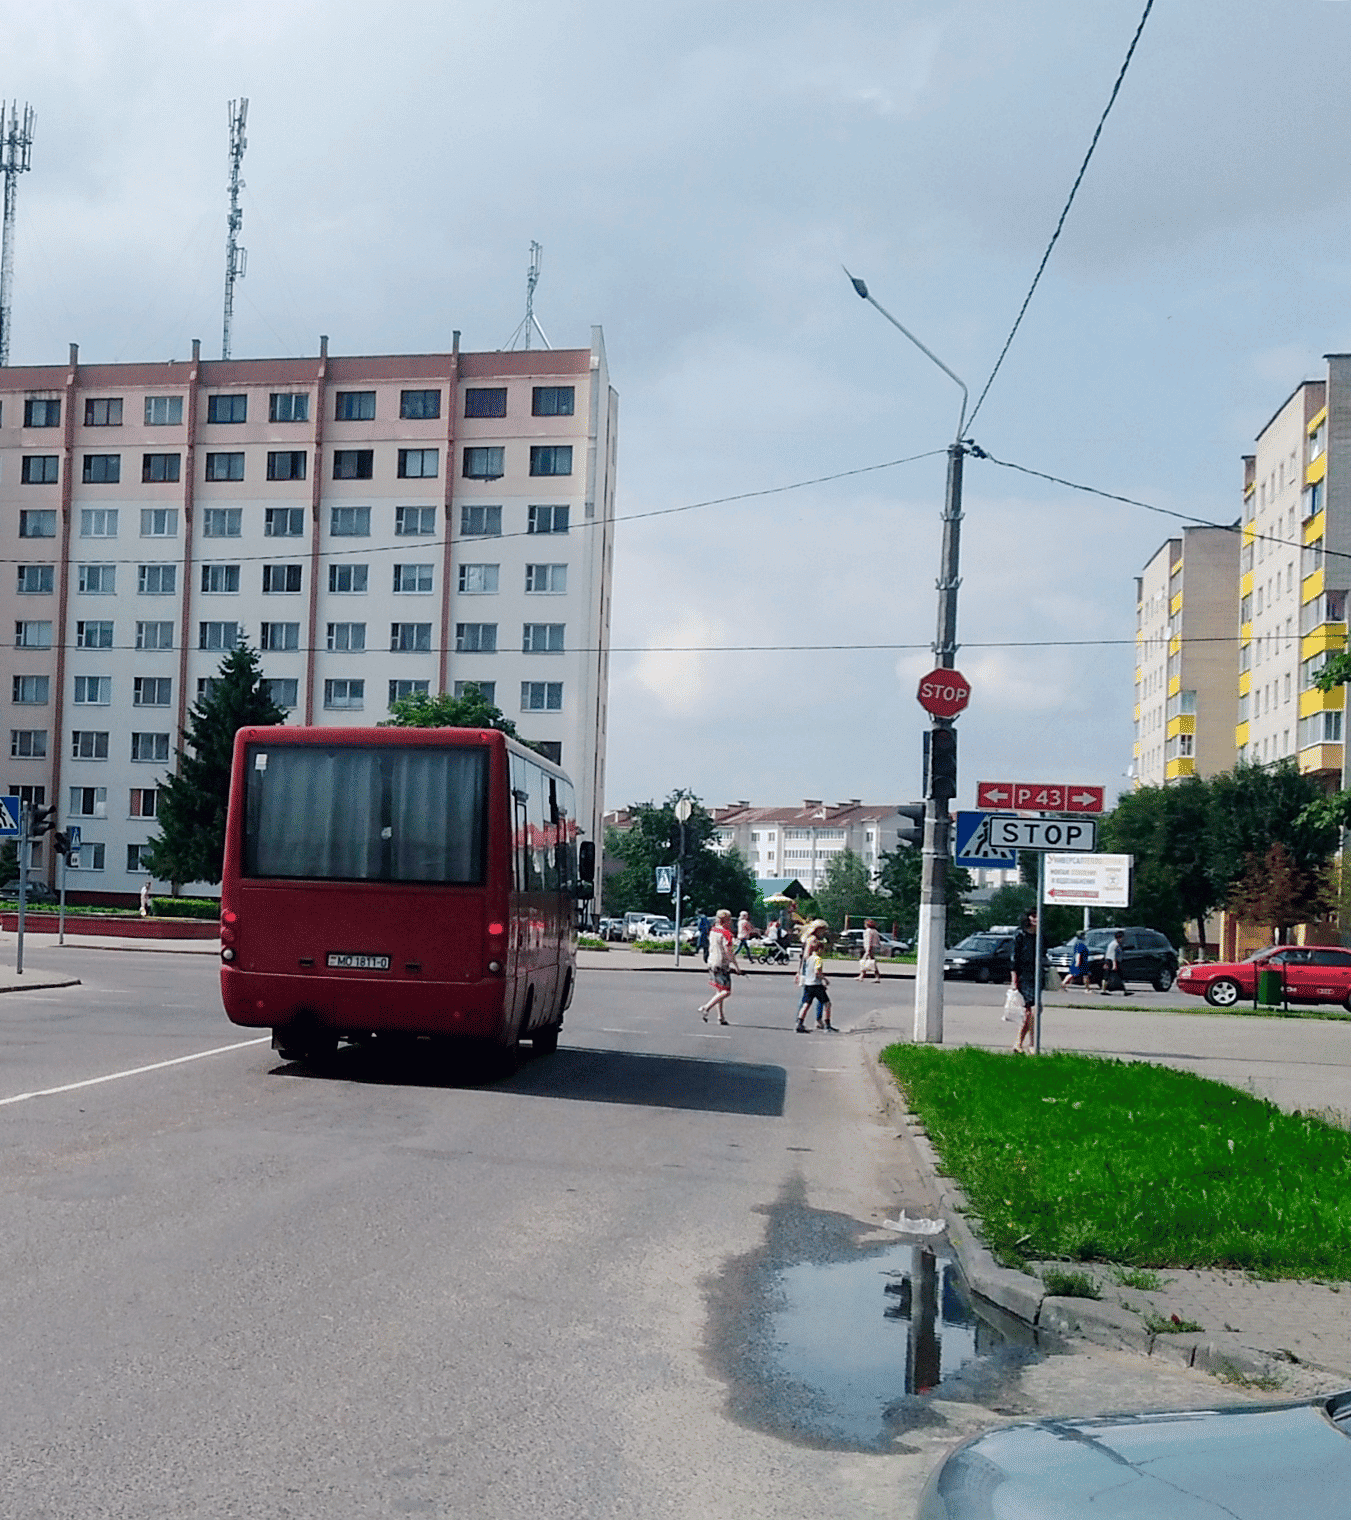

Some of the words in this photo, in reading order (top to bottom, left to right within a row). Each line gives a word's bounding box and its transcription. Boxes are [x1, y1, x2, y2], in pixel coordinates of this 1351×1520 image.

[920, 682, 968, 702] STOP
[1035, 790, 1061, 806] 43
[1002, 822, 1083, 846] STOP
